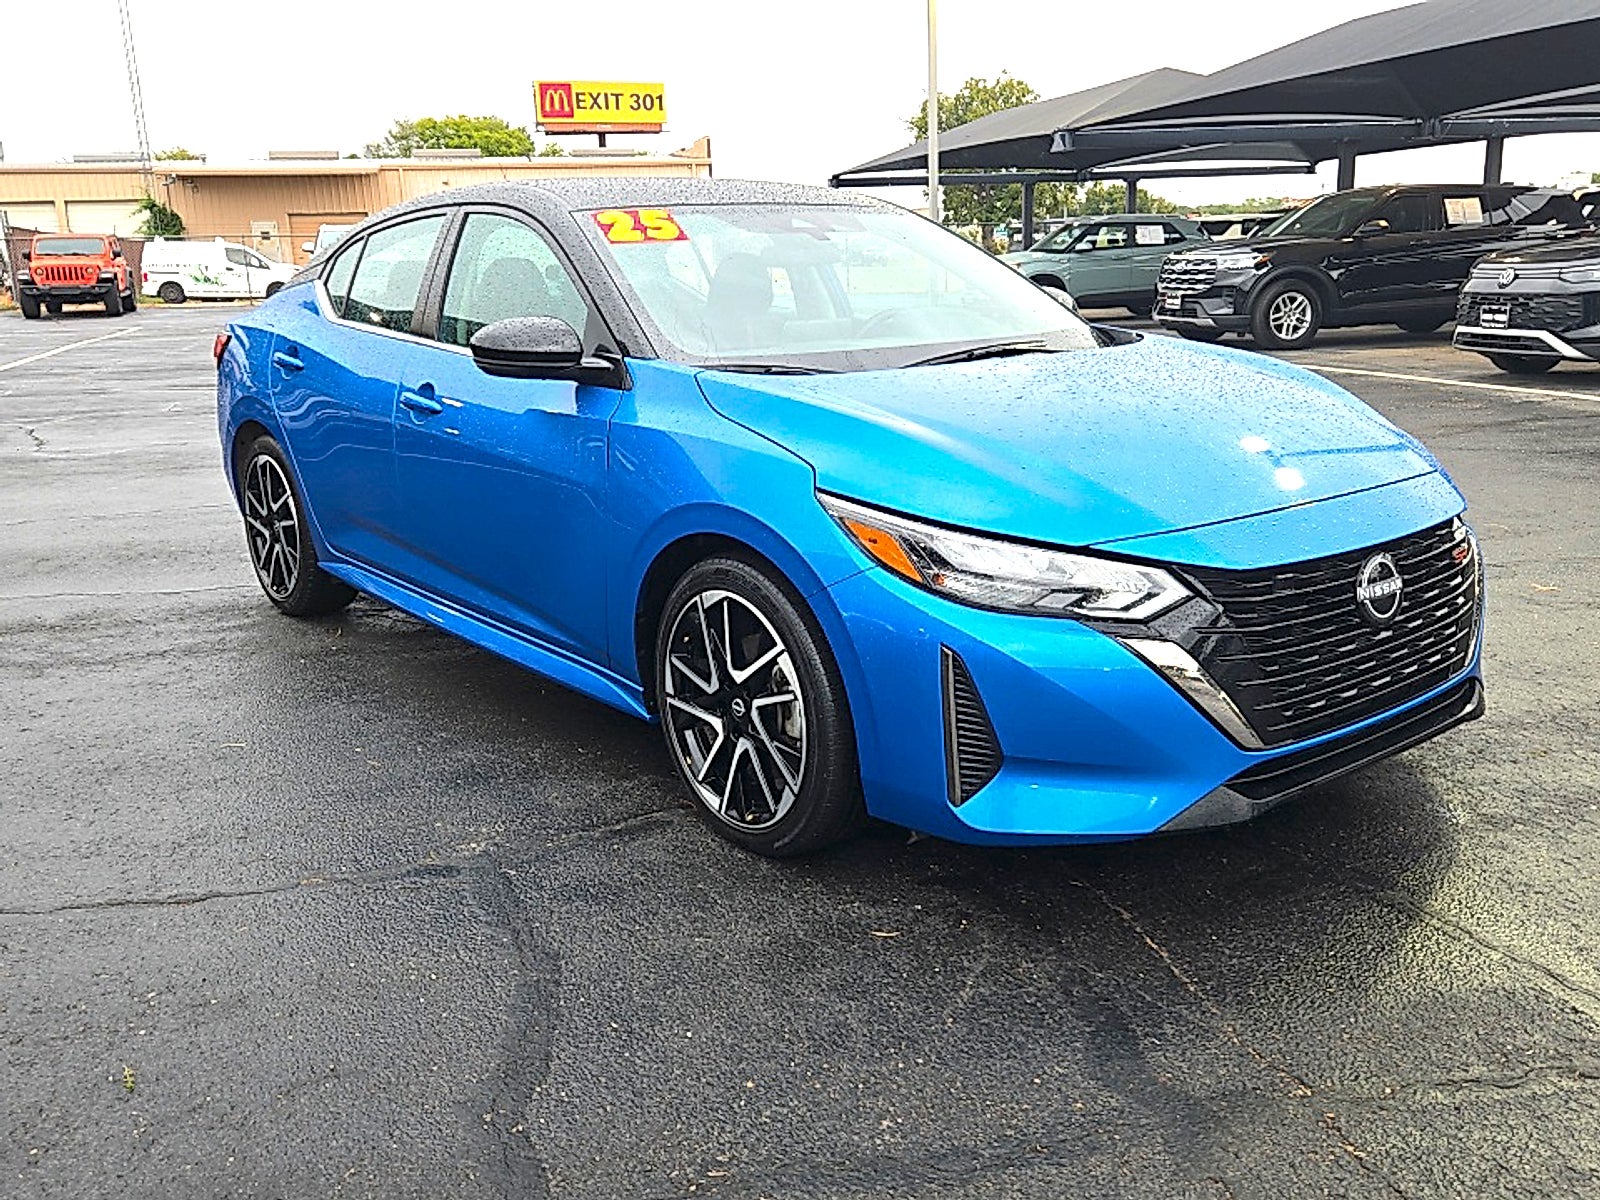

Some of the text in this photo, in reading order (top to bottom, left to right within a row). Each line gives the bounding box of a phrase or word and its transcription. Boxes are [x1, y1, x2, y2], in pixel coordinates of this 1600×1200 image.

[575, 92, 664, 111] EXIT 301
[596, 208, 681, 242] 25
[1356, 576, 1403, 603] NISSAN
